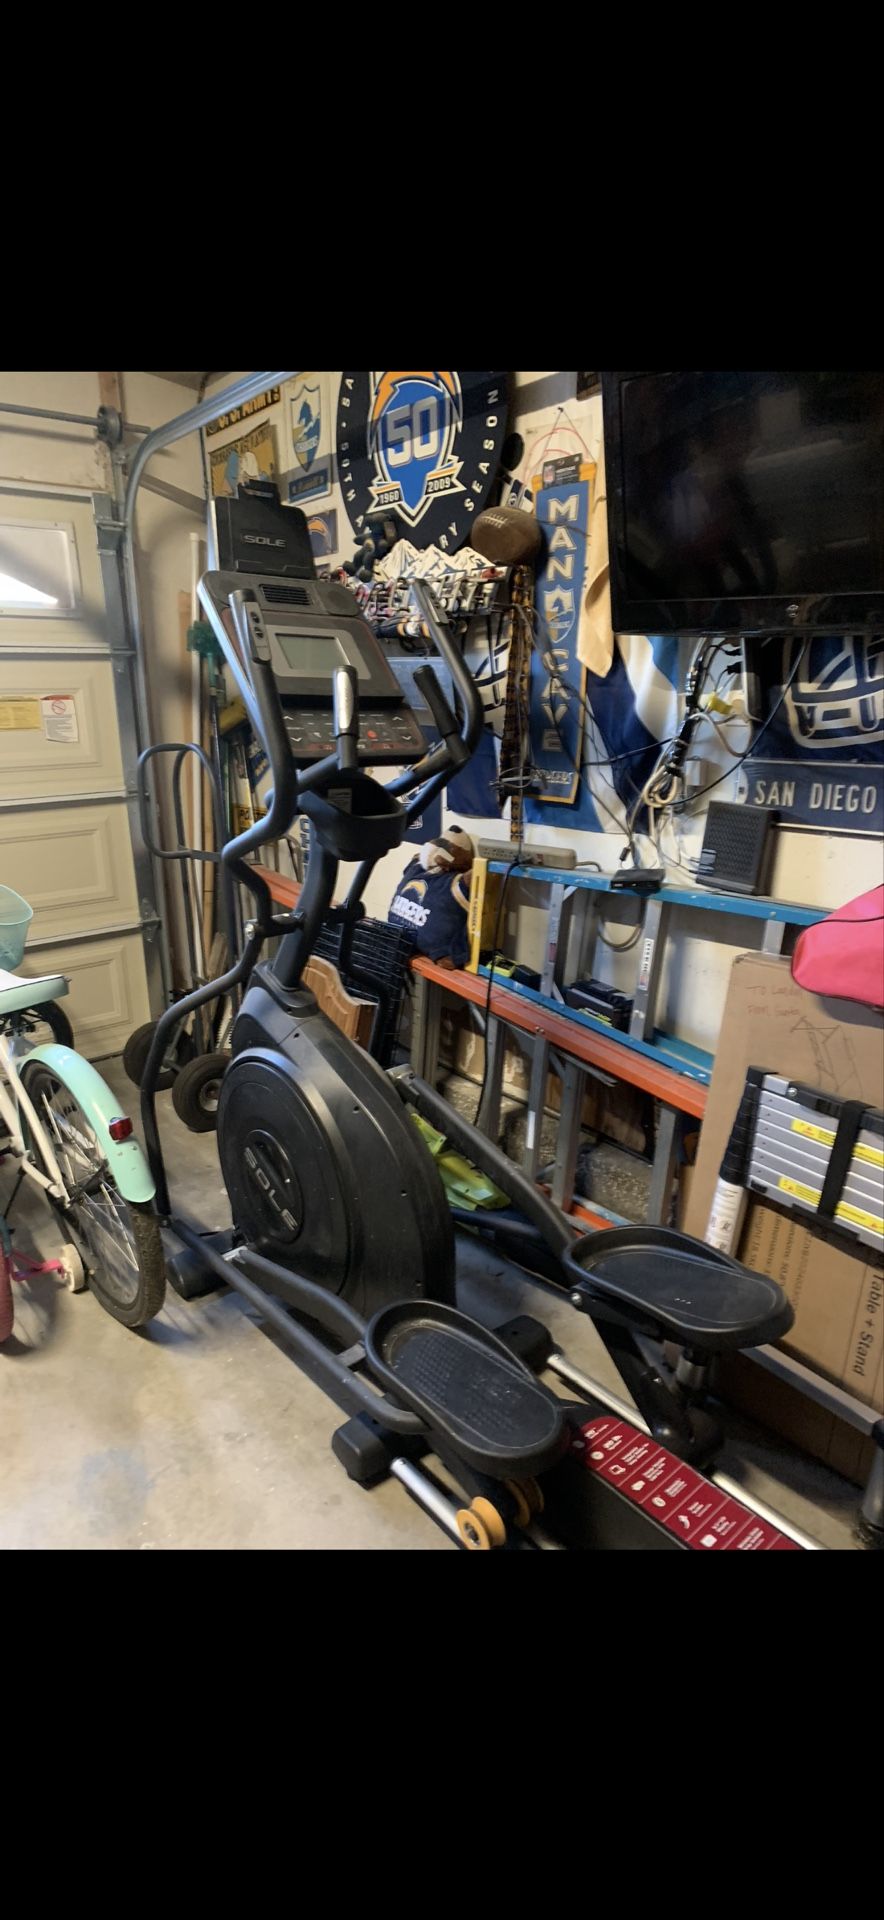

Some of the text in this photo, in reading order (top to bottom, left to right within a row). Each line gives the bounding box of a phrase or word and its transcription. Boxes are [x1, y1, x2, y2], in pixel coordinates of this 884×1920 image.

[387, 396, 439, 468] 50
[464, 389, 499, 512] SEASON
[379, 490, 400, 504] 1960
[427, 478, 451, 493] 2009
[243, 535, 287, 548] SOLE
[547, 494, 579, 582] MAN
[541, 648, 571, 752] CAVE
[754, 780, 877, 813] SAN DIEGO
[243, 1146, 299, 1231] SOLE
[867, 1273, 884, 1314] Table
[853, 1331, 874, 1377] Stand
